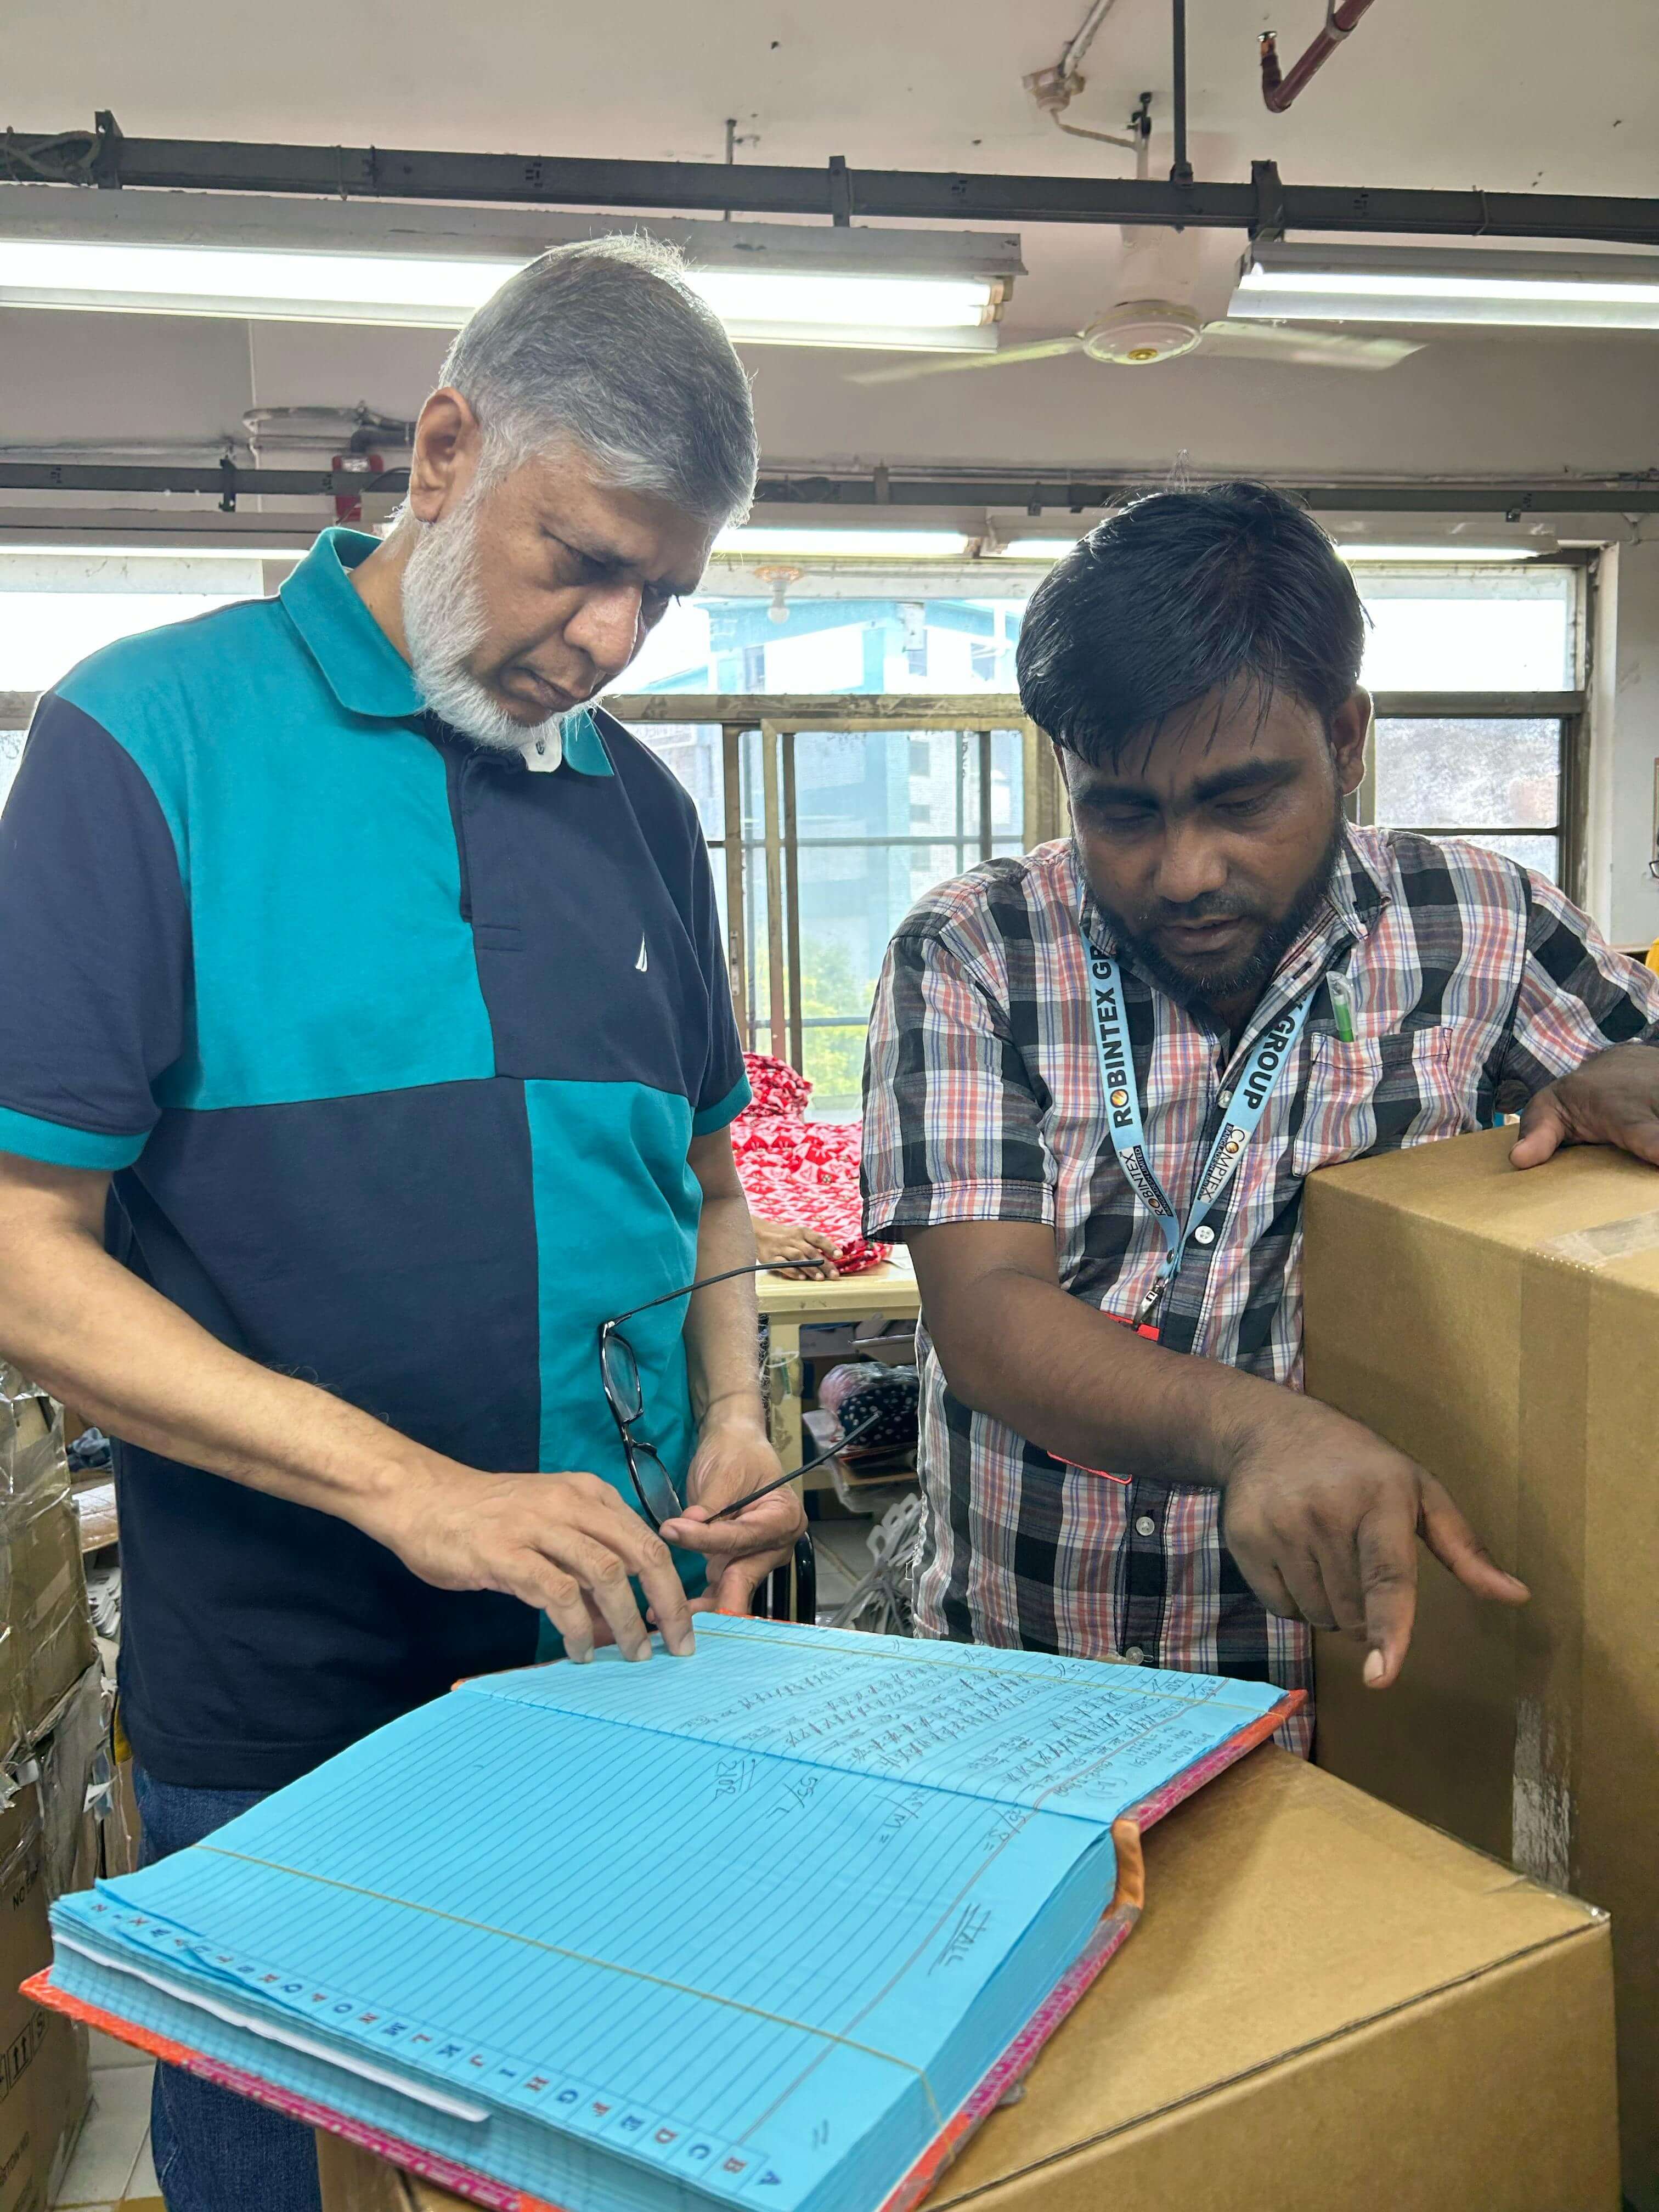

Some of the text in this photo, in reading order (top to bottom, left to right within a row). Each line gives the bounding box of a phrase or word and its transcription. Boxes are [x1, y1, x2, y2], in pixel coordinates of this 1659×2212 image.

[1095, 988, 1133, 1128] ROBINTEX
[1243, 1015, 1296, 1109] GROUP
[1135, 1147, 1149, 1176] LIMITED
[1201, 1129, 1245, 1200] COMPTEX
[1123, 1153, 1166, 1216] ROBINTEX
[280, 1983, 303, 1993] Q
[333, 2002, 353, 2014] O
[410, 2033, 433, 2044] L
[437, 2044, 462, 2058] K
[499, 2068, 517, 2078] I
[524, 2075, 550, 2092] H
[556, 2089, 579, 2104] G
[655, 2128, 679, 2145] D
[689, 2143, 710, 2159] C
[723, 2157, 748, 2174] B
[755, 2170, 782, 2186] A
